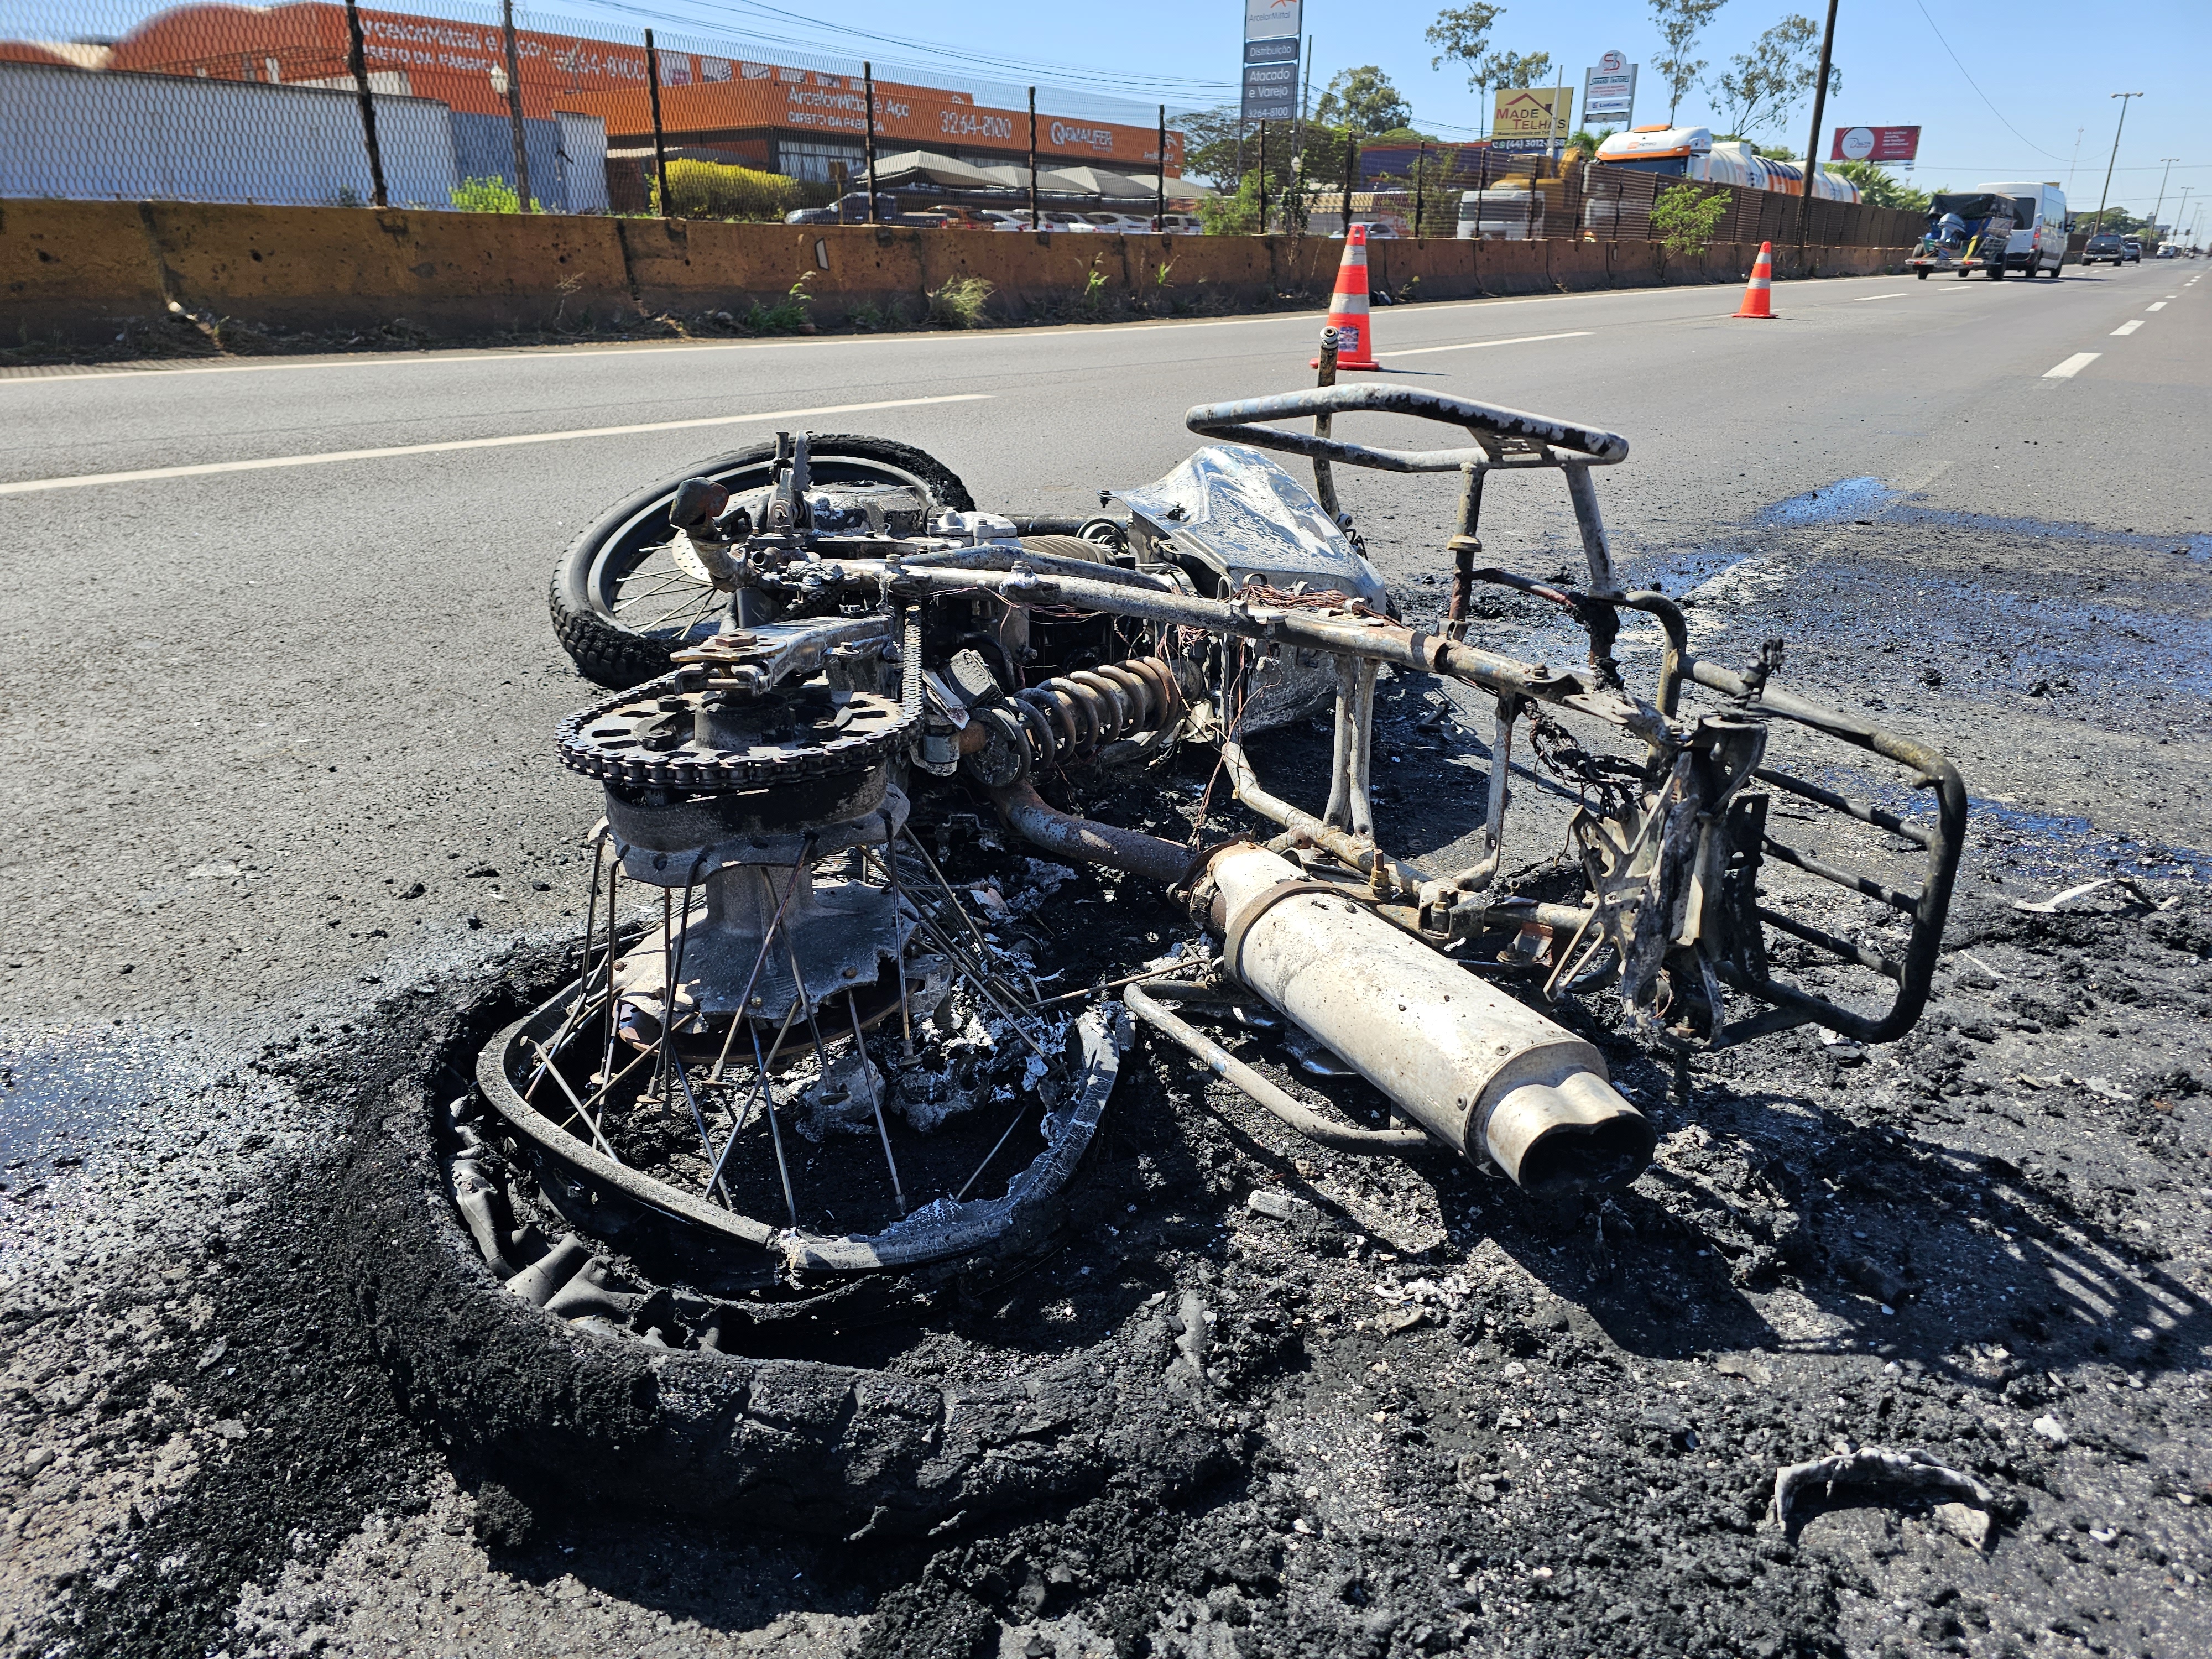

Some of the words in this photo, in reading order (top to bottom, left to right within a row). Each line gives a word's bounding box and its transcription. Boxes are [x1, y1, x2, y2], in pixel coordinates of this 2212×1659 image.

[1248, 11, 1291, 22] ArcelorMittal
[1250, 45, 1291, 56] Distribuição
[1249, 67, 1290, 82] Atacado
[1249, 89, 1255, 98] e
[1258, 85, 1288, 98] Varejo
[885, 98, 910, 119] Aço
[1496, 108, 1539, 119] MADE
[1507, 139, 1523, 149] (44)
